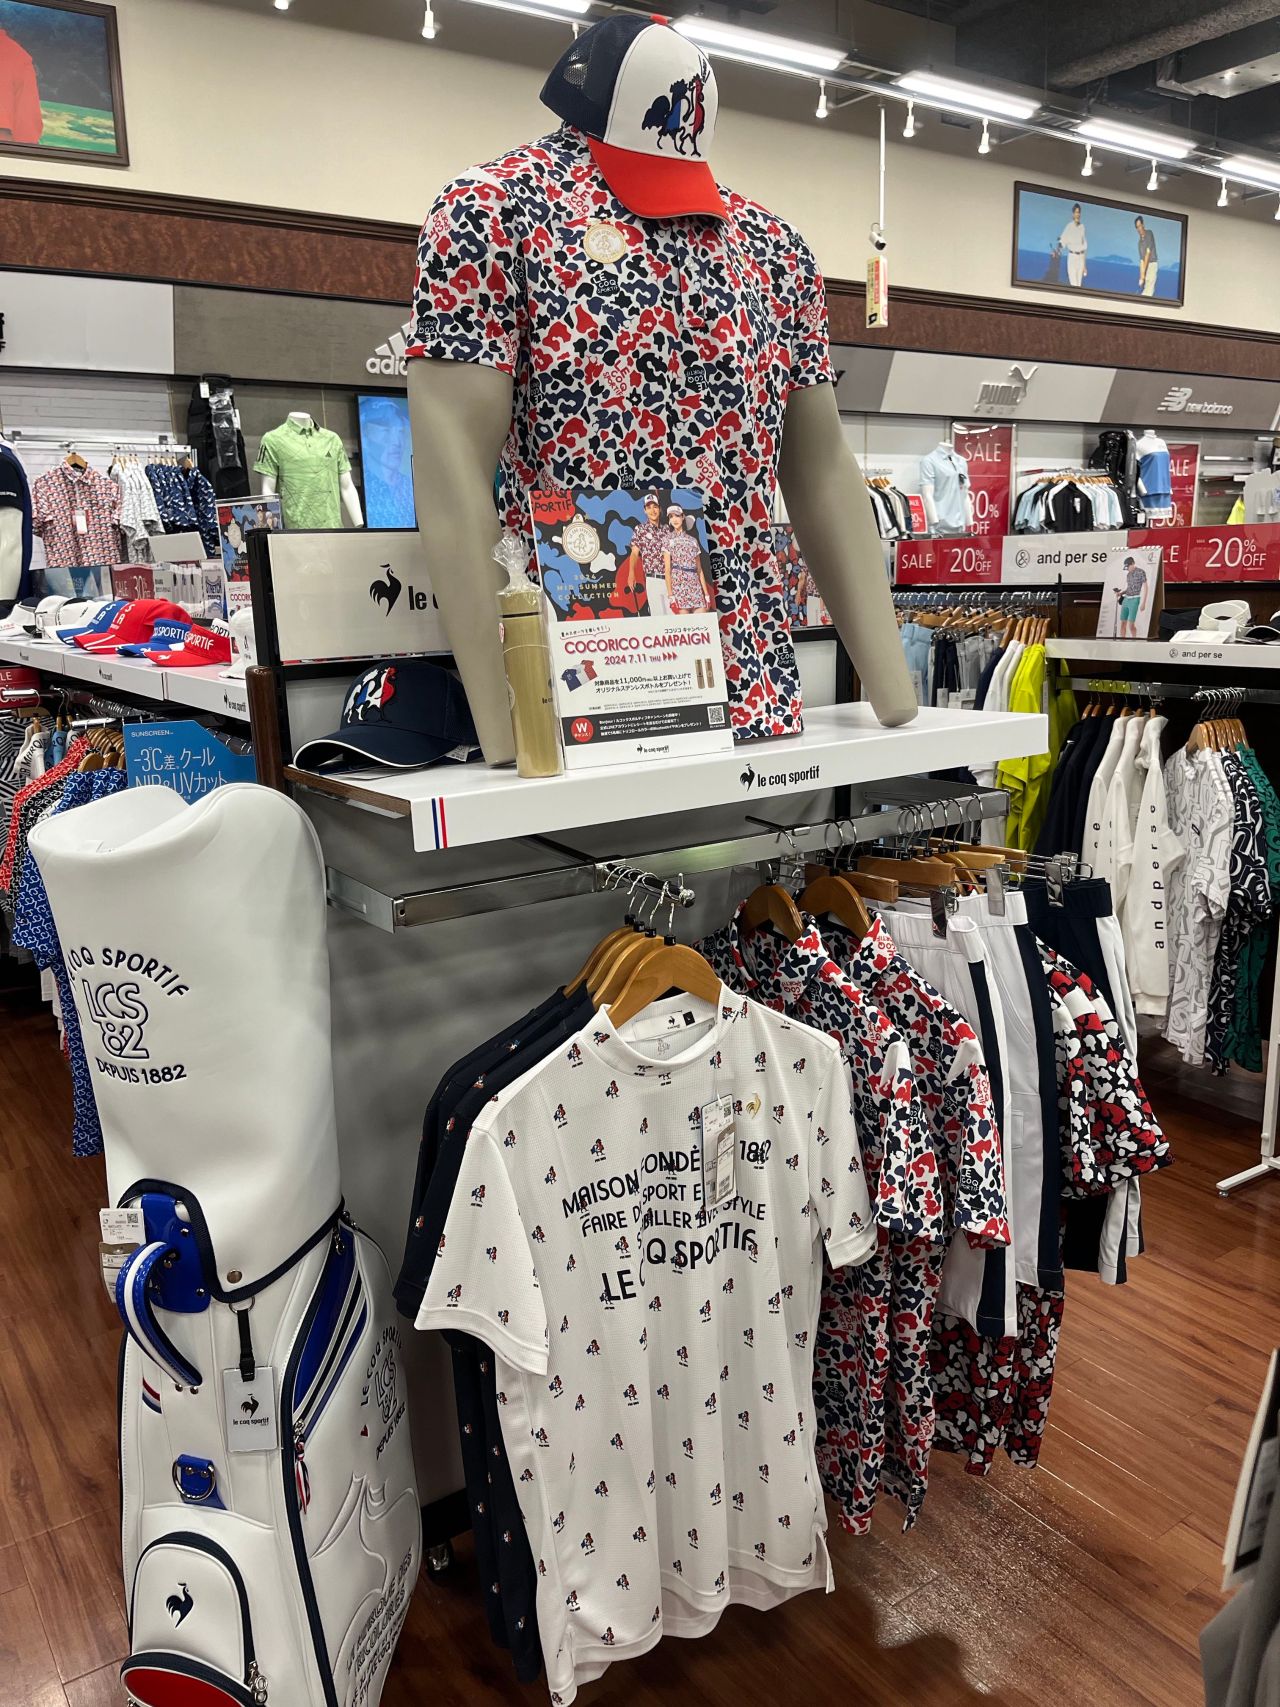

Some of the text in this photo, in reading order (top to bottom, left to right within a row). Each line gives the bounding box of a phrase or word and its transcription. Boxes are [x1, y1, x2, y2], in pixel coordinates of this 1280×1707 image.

[964, 443, 1002, 462] SALE
[902, 553, 933, 569] SALE
[975, 561, 992, 572] OFF
[1037, 551, 1061, 565] and
[1065, 550, 1086, 567] per
[1091, 550, 1107, 563] se
[1242, 553, 1267, 567] OFF
[408, 585, 427, 610] le
[564, 632, 710, 654] COCORICO CAMPAIGN
[575, 722, 588, 733] W
[758, 765, 820, 787] le coq sportif
[102, 948, 190, 996] SPORTIF
[95, 1057, 187, 1085] DEPUIS 1882
[562, 1168, 640, 1218] MAISON
[581, 1210, 630, 1238] FAIRE
[642, 1183, 687, 1205] SPORT
[601, 1269, 637, 1301] LE
[674, 1221, 757, 1269] SPORTIF
